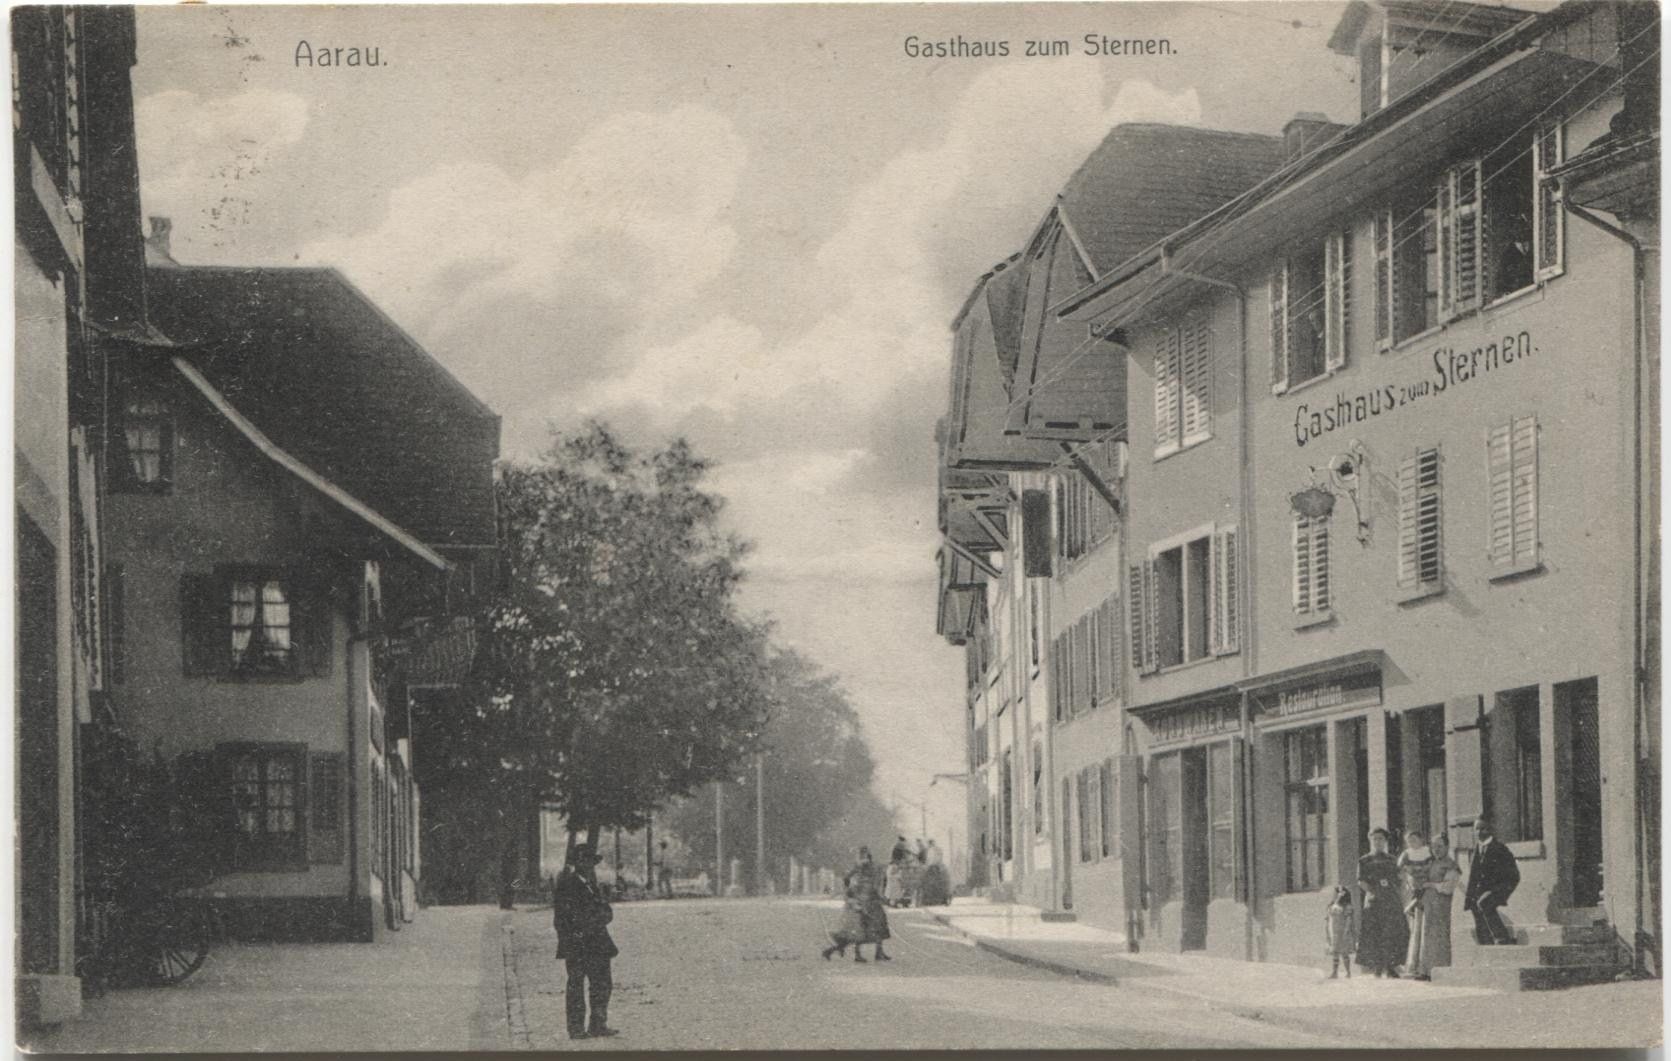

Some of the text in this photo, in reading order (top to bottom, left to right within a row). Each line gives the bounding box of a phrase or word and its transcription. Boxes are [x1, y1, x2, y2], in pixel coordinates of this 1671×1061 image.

[1294, 330, 1540, 447] Gasthaus zum Sternen.
